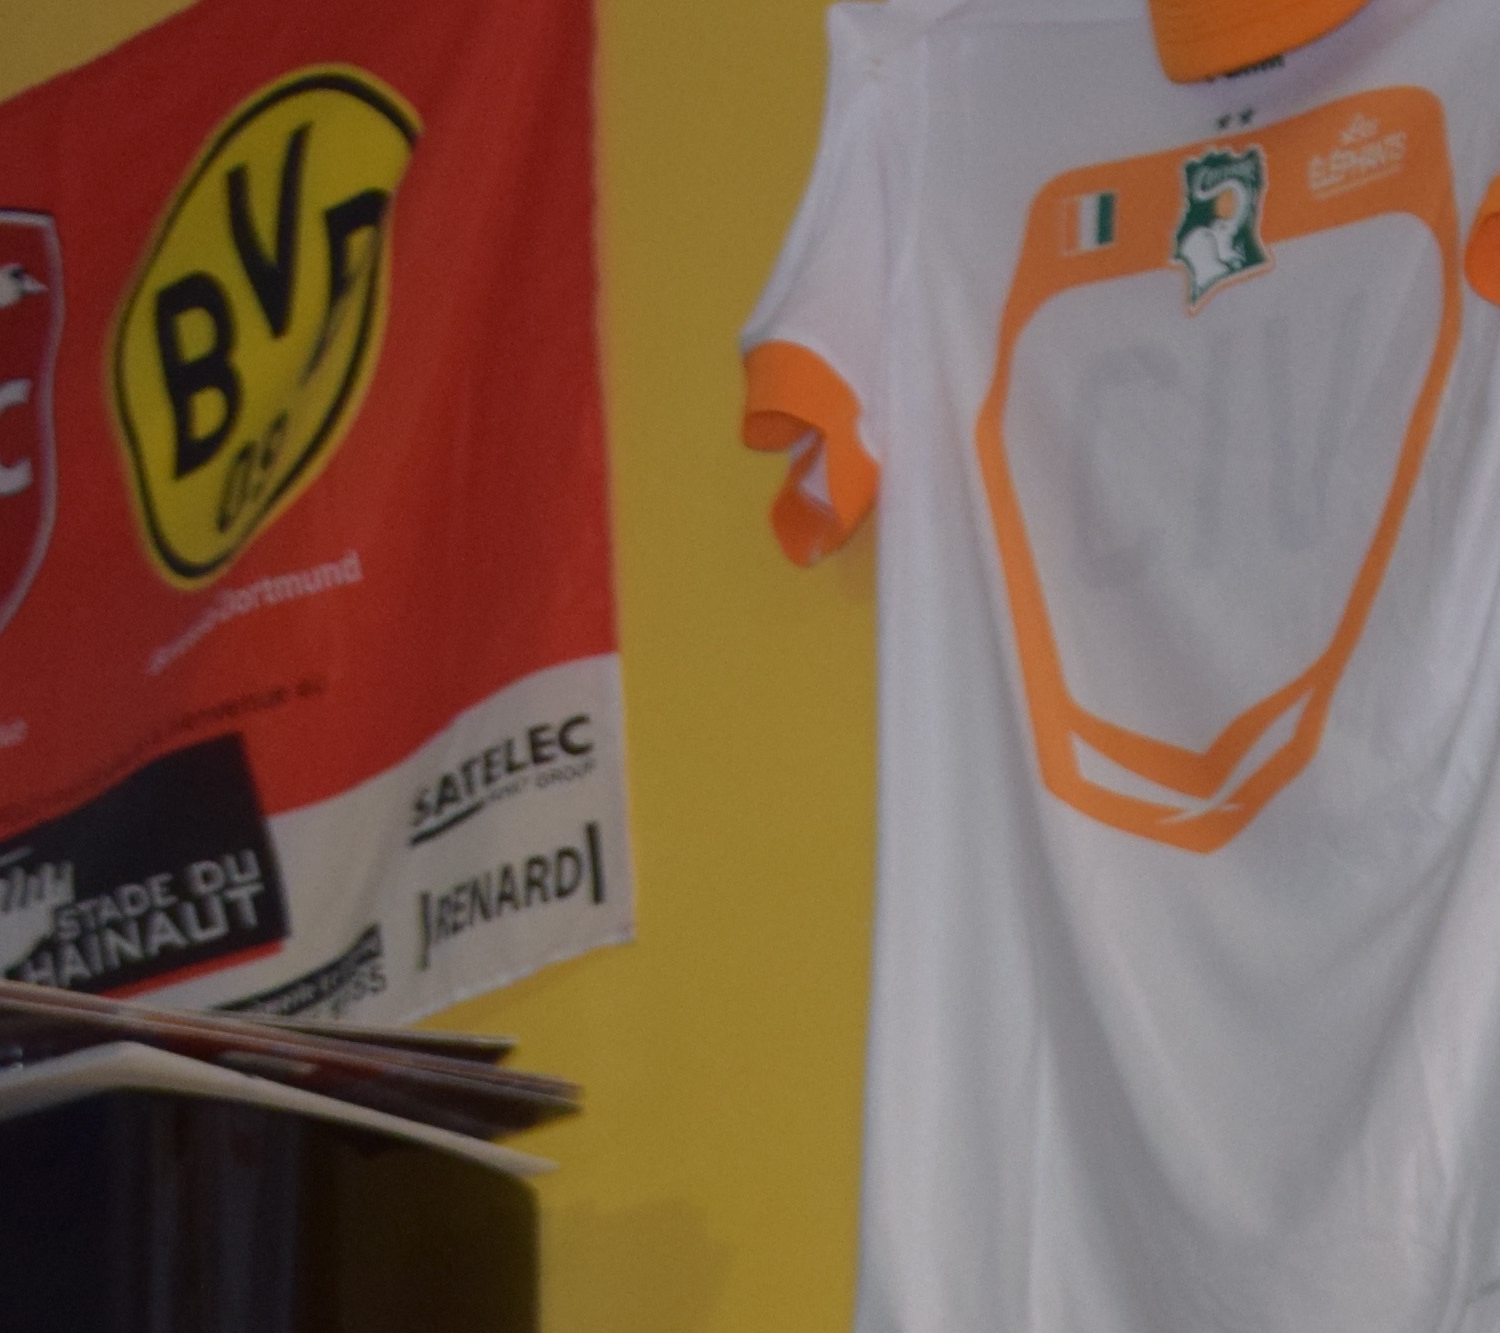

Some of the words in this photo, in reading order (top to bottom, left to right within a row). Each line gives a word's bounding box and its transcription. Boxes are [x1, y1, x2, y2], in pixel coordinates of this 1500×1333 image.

[409, 714, 596, 830] SATELEC
[16, 881, 267, 996] HAINAUT
[55, 872, 177, 942] STADE
[183, 849, 263, 901] DU
[431, 845, 584, 943] RENARD
